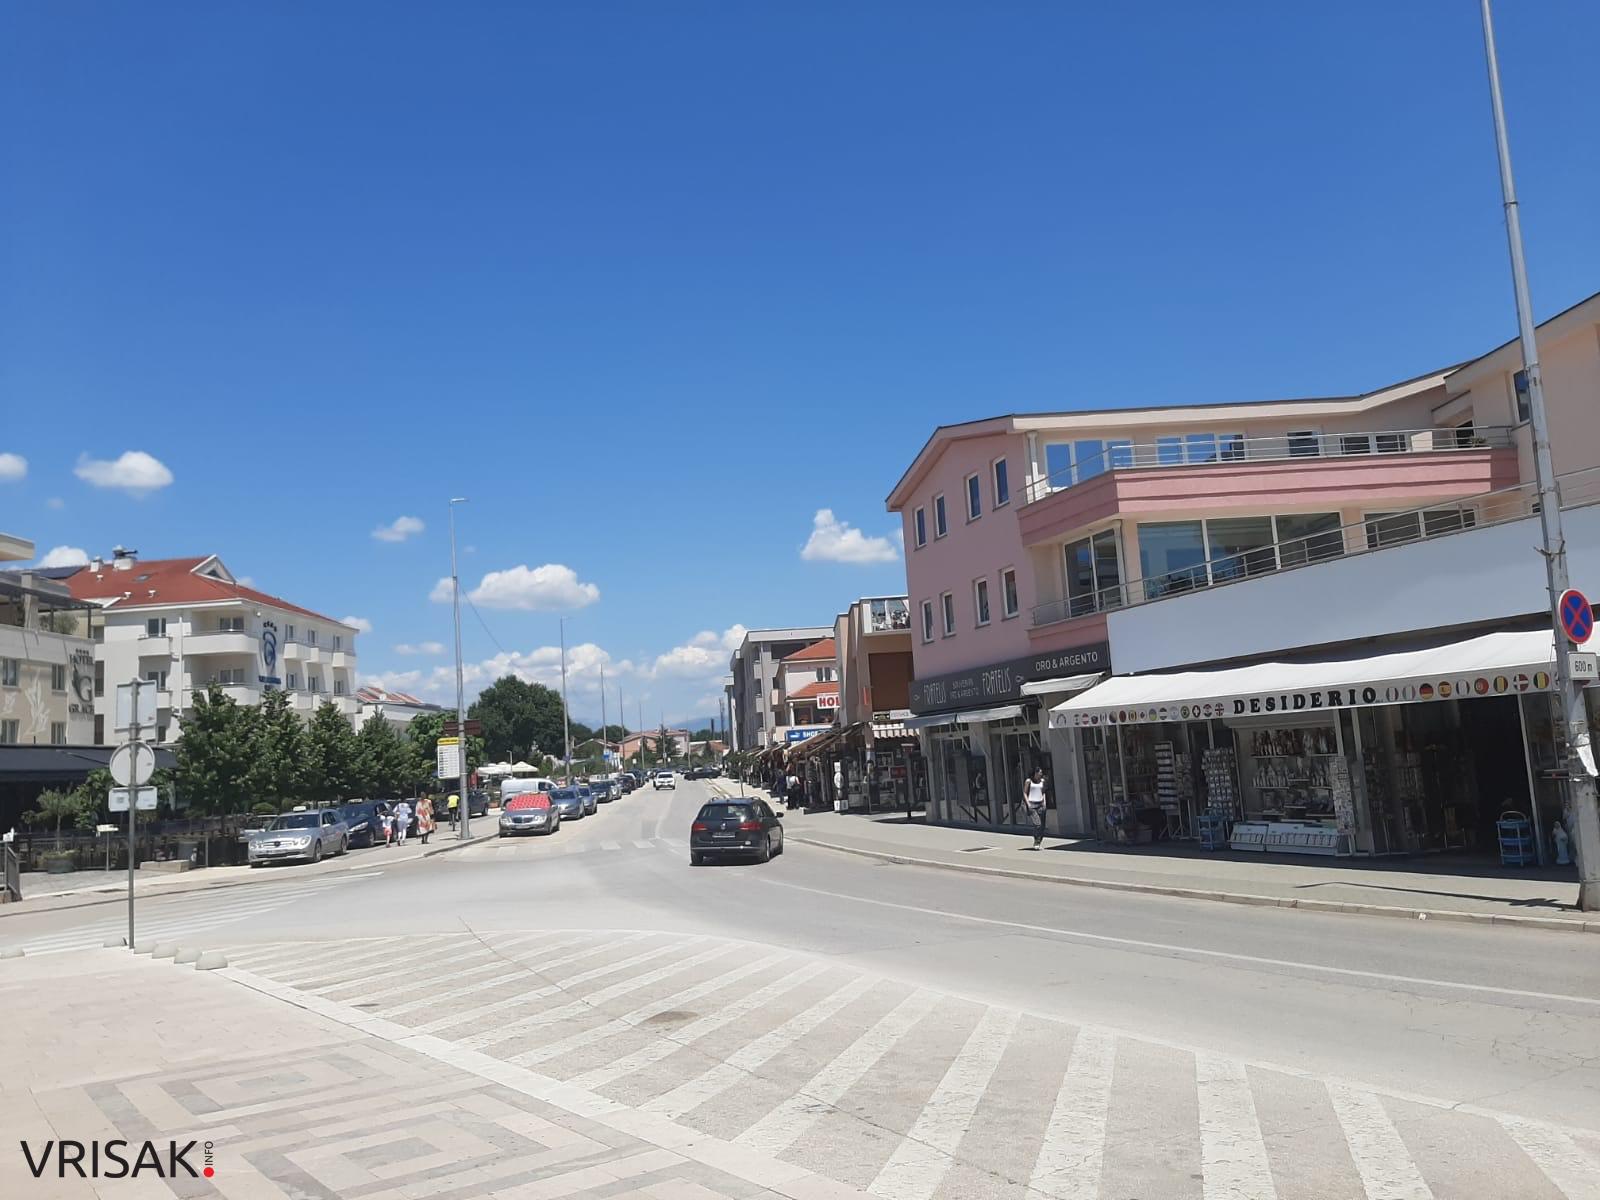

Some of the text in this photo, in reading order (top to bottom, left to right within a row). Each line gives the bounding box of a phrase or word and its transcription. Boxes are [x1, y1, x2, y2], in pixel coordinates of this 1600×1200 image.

[69, 654, 94, 665] HOTEL
[1035, 651, 1098, 672] ORO & ARGENTO
[1574, 661, 1586, 672] 600
[1233, 686, 1377, 715] DESIDERIO
[68, 703, 95, 714] GRACE
